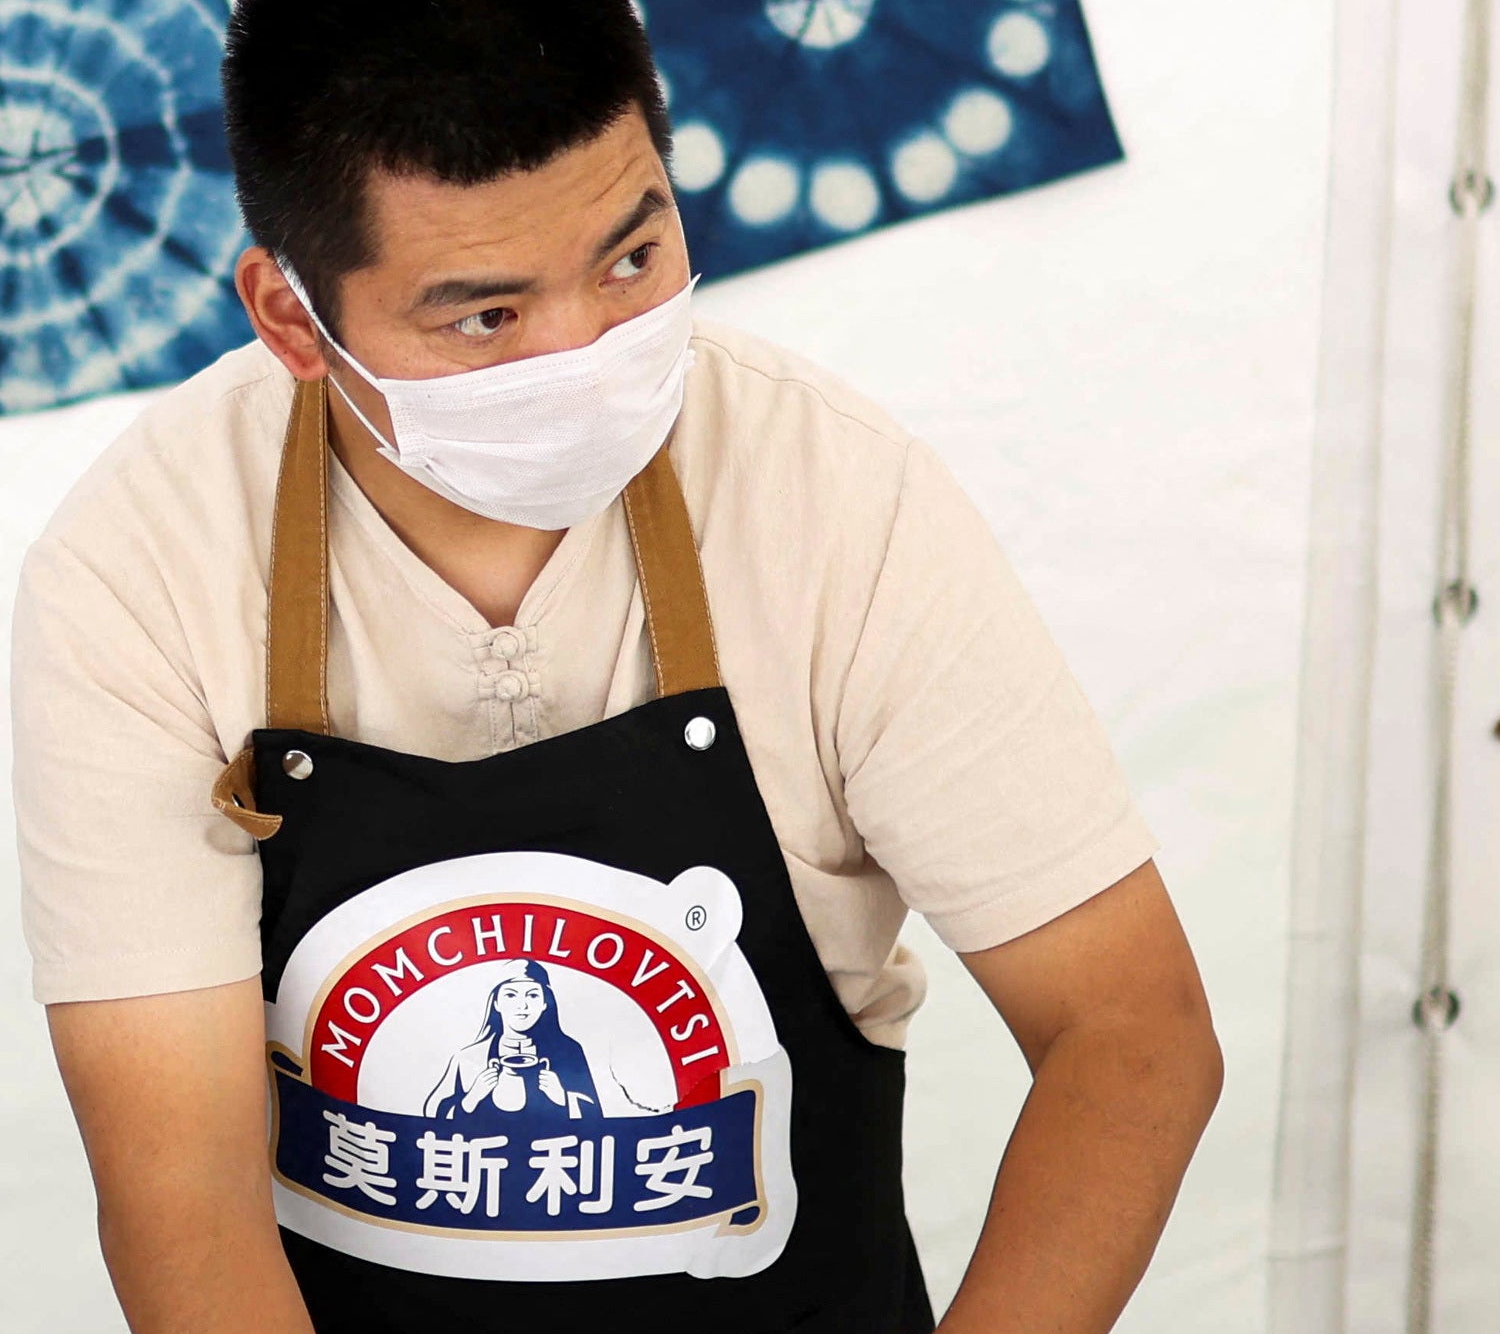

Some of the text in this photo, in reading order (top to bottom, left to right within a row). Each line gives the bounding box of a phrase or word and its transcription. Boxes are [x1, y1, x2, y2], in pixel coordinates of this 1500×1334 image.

[321, 914, 718, 1068] MOMCHILOVTSI
[322, 1110, 714, 1218] 莫斯利安
